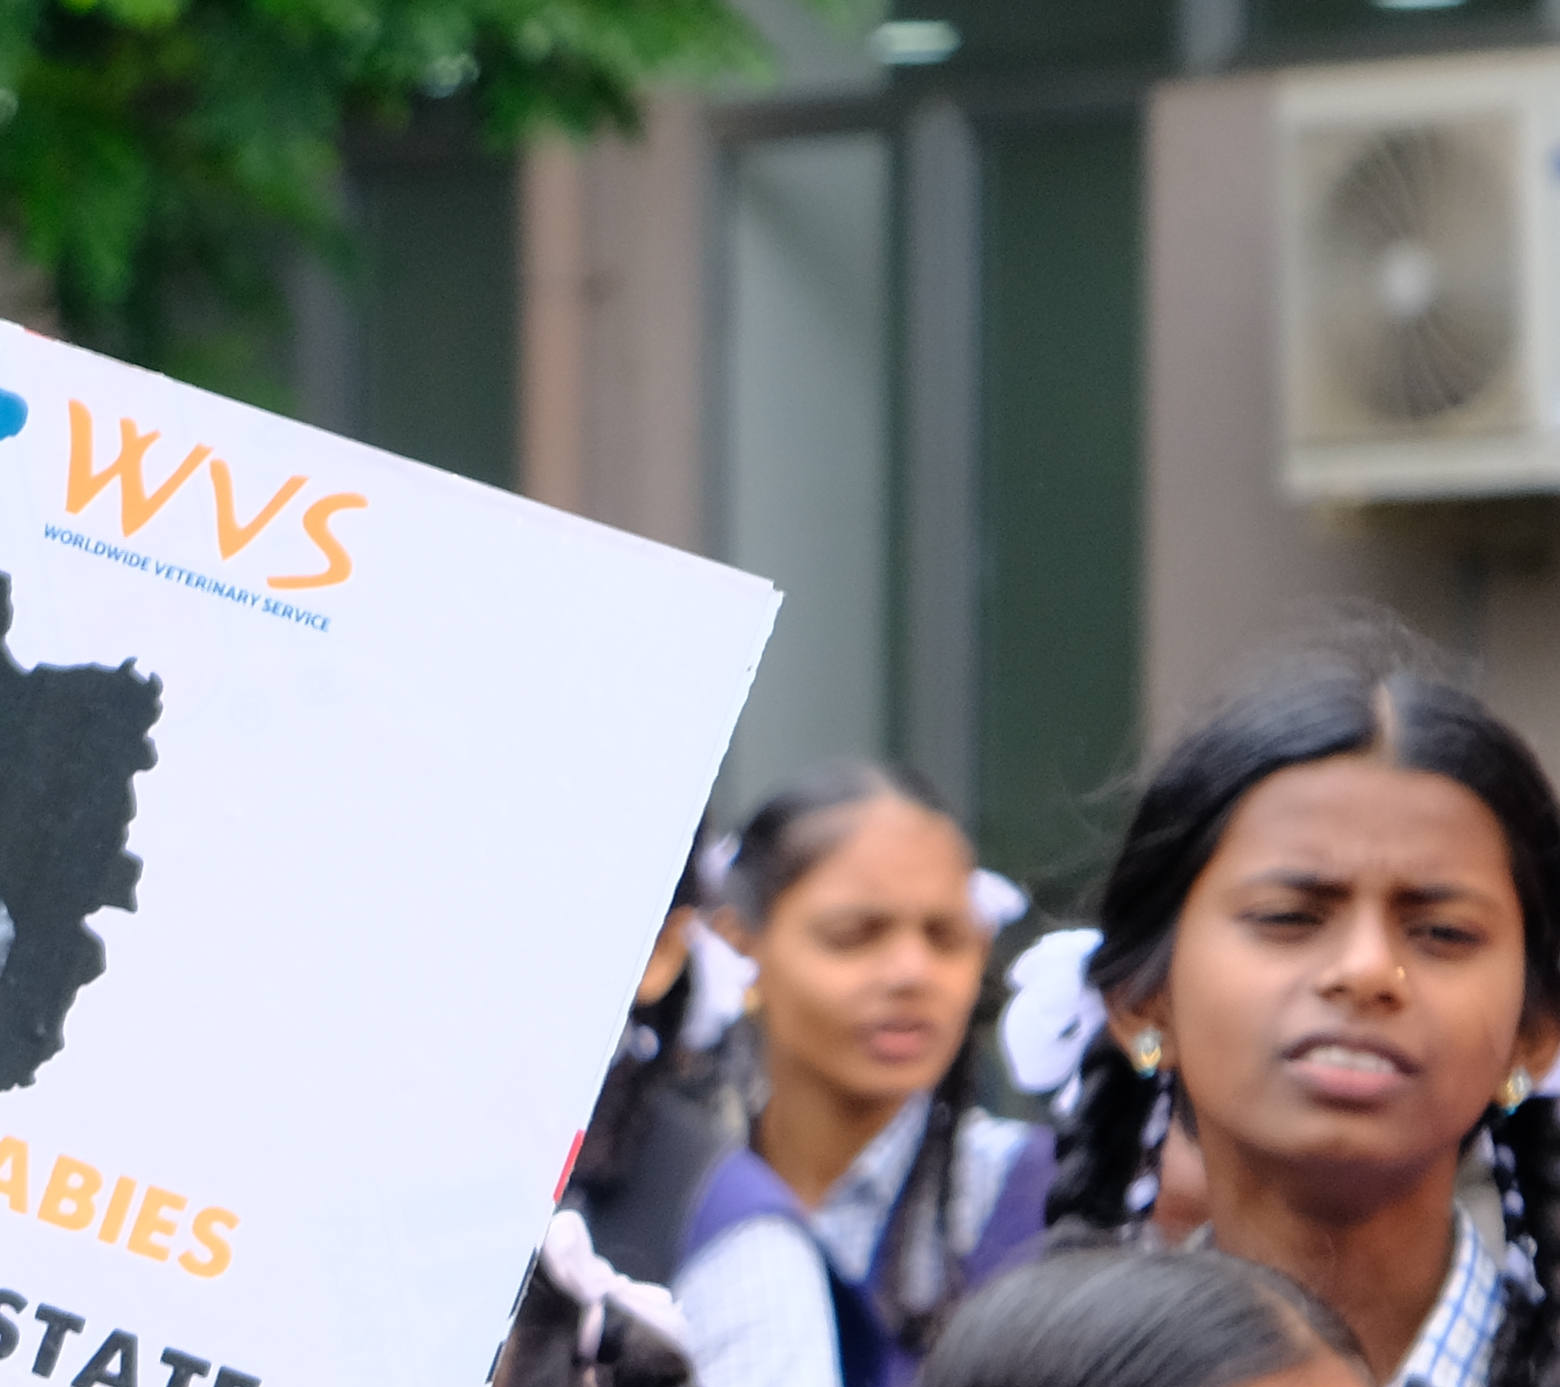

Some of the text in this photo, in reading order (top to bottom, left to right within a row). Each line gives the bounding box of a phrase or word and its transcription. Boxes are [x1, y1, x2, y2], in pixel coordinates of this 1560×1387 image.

[65, 398, 368, 590] WVS
[43, 522, 331, 633] WORLDWIDE VETERINARY SERVICE
